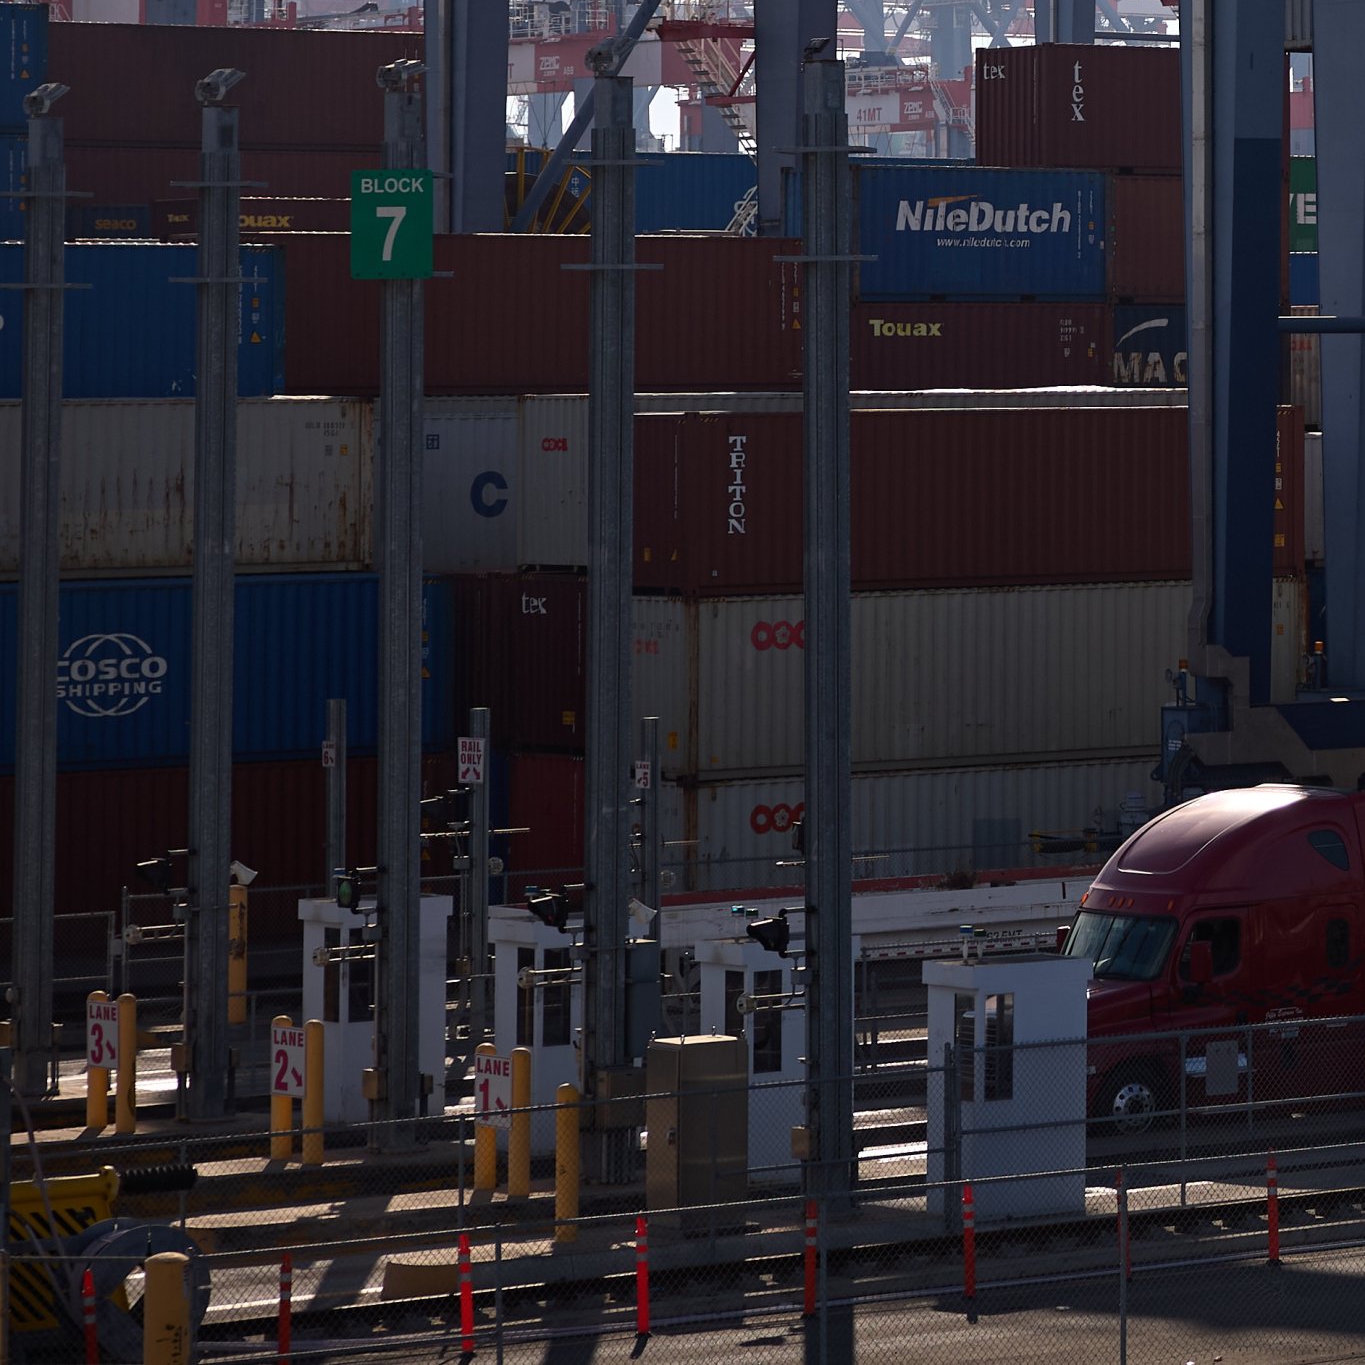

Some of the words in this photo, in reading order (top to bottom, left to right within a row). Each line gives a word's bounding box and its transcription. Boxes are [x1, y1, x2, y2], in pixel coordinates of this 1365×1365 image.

[983, 60, 1005, 81] tex
[1070, 60, 1086, 123] tex
[857, 107, 882, 122] 41MT
[360, 177, 424, 194] BLOCK
[95, 218, 136, 230] seaco
[239, 215, 290, 228] ouax
[896, 200, 1071, 234] NileDutch
[375, 205, 406, 262] 7
[869, 319, 942, 337] Touax
[1114, 352, 1168, 384] MA
[728, 435, 746, 534] TRITON
[521, 593, 547, 615] tex
[55, 680, 162, 698] SHIPPING
[461, 741, 481, 752] RAIL
[460, 753, 482, 765] ONLY
[89, 1006, 117, 1021] LANE
[90, 1028, 104, 1065] 3
[273, 1029, 304, 1047] LANE
[274, 1049, 289, 1091] 2
[476, 1054, 510, 1077] LANE
[479, 1078, 490, 1110] 1
